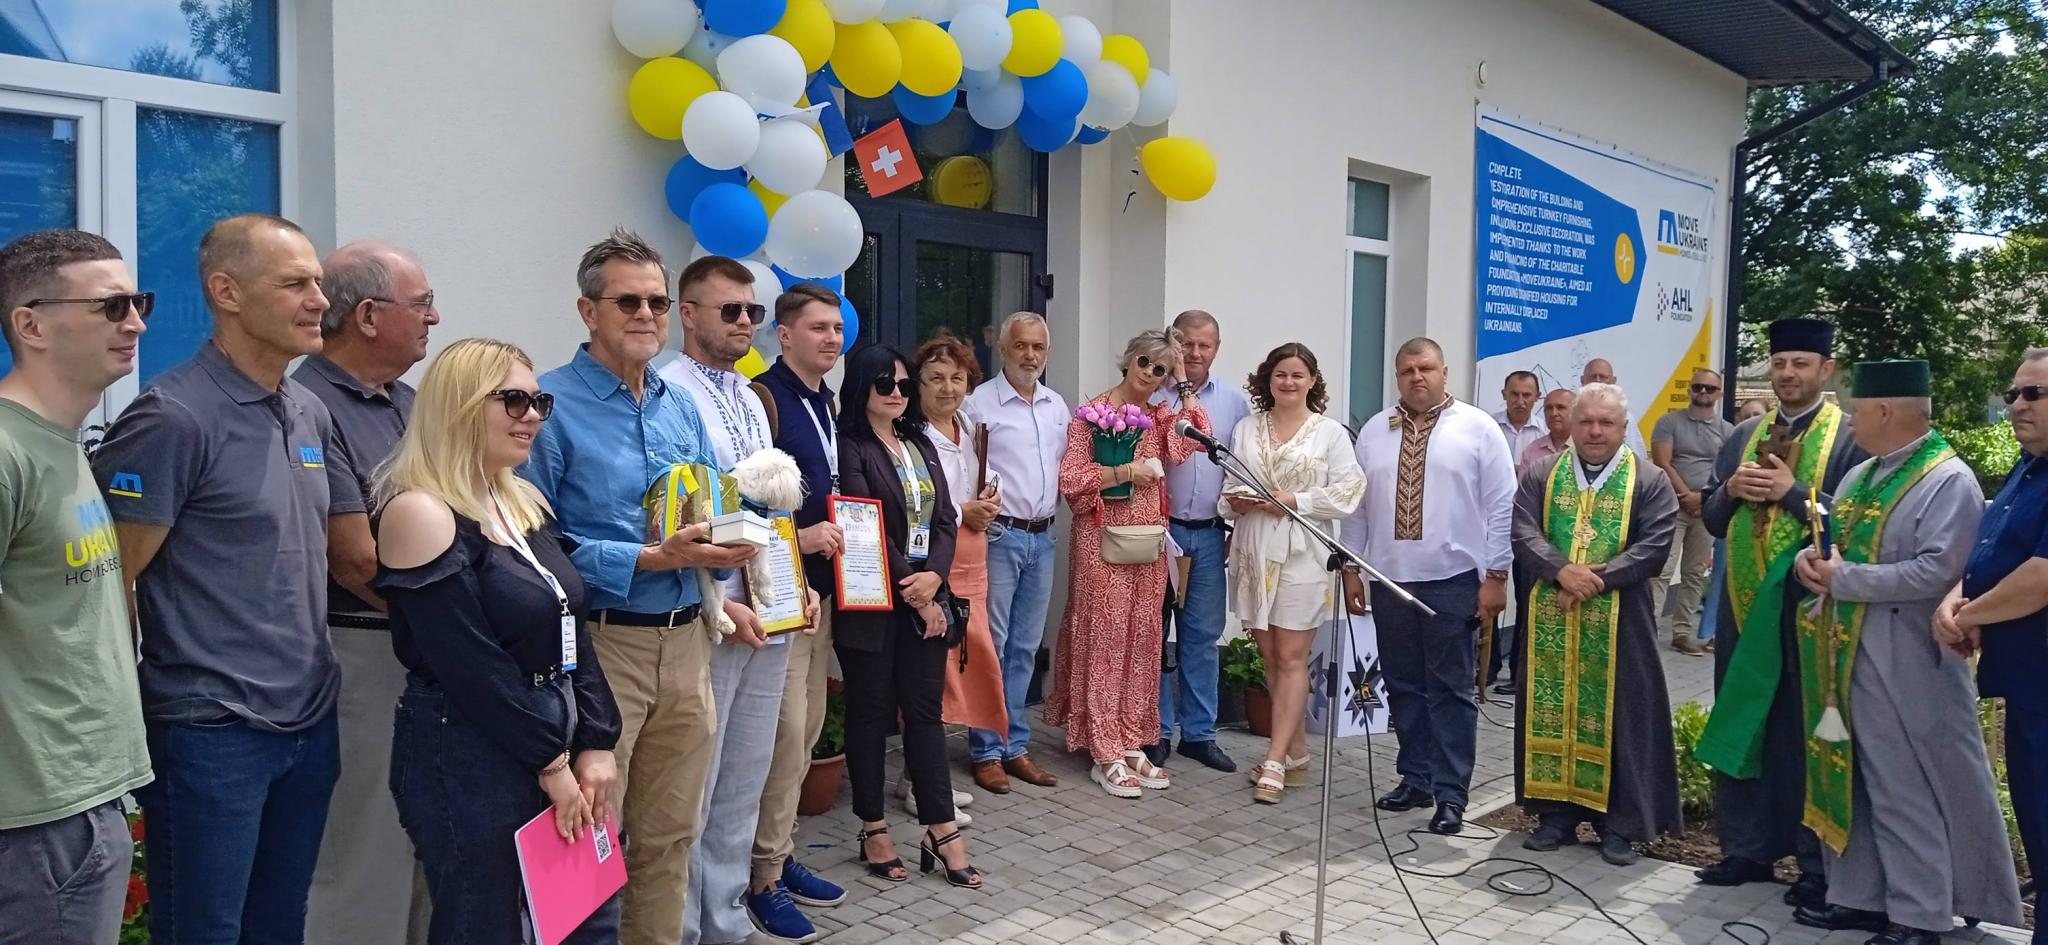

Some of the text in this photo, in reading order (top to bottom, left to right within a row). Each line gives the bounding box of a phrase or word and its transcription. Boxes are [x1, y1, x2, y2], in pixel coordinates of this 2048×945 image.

[1531, 188, 1538, 200] OF
[1539, 190, 1549, 203] THE
[1550, 193, 1572, 209] BUILDING
[1573, 199, 1584, 211] AND
[1538, 207, 1563, 223] TURNKEY
[1678, 213, 1698, 233] MOVE
[1490, 214, 1516, 231] INLUDING
[1517, 221, 1550, 237] EXCLUSIVE
[1584, 234, 1595, 245] WAS
[1526, 240, 1551, 253] THANKS
[1553, 244, 1560, 255] TO
[1561, 245, 1571, 256] THE
[1572, 248, 1586, 259] WORK
[1679, 232, 1708, 253] UKRAINE
[1490, 249, 1503, 262] AND
[1528, 257, 1537, 268] OF
[1538, 258, 1550, 270] THE
[1551, 260, 1584, 275] CHARITABLE
[1568, 279, 1585, 291] AIMED
[1585, 281, 1592, 292] AT
[1540, 292, 1566, 305] HOUSING
[1566, 294, 1578, 306] FOR
[1671, 287, 1692, 313] AHL
